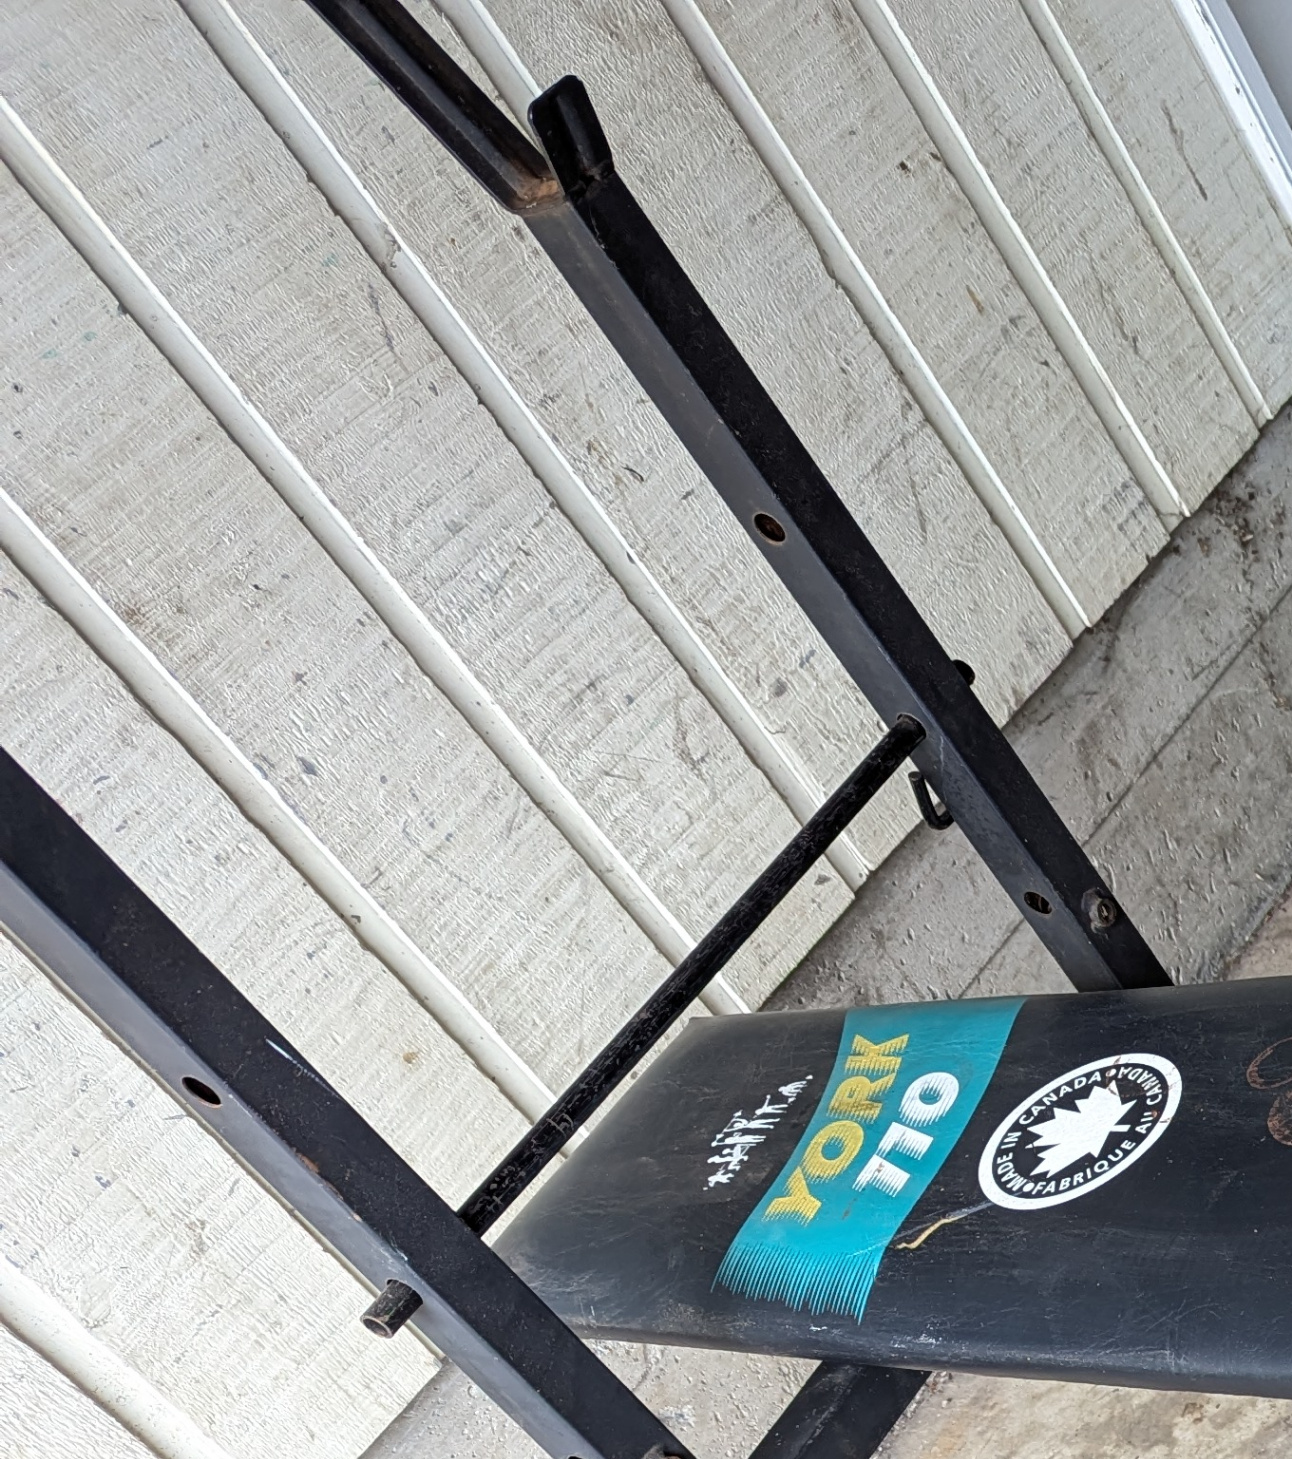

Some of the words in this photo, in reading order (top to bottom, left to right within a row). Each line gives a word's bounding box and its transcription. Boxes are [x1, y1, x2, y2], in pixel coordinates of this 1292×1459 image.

[1018, 1071, 1102, 1125] CANADA
[762, 1034, 910, 1227] YORK
[1000, 1130, 1022, 1150] IN
[1031, 1139, 1136, 1195] FABRIQUE
[1117, 1066, 1163, 1106] CANADA
[996, 1151, 1025, 1193] MADE
